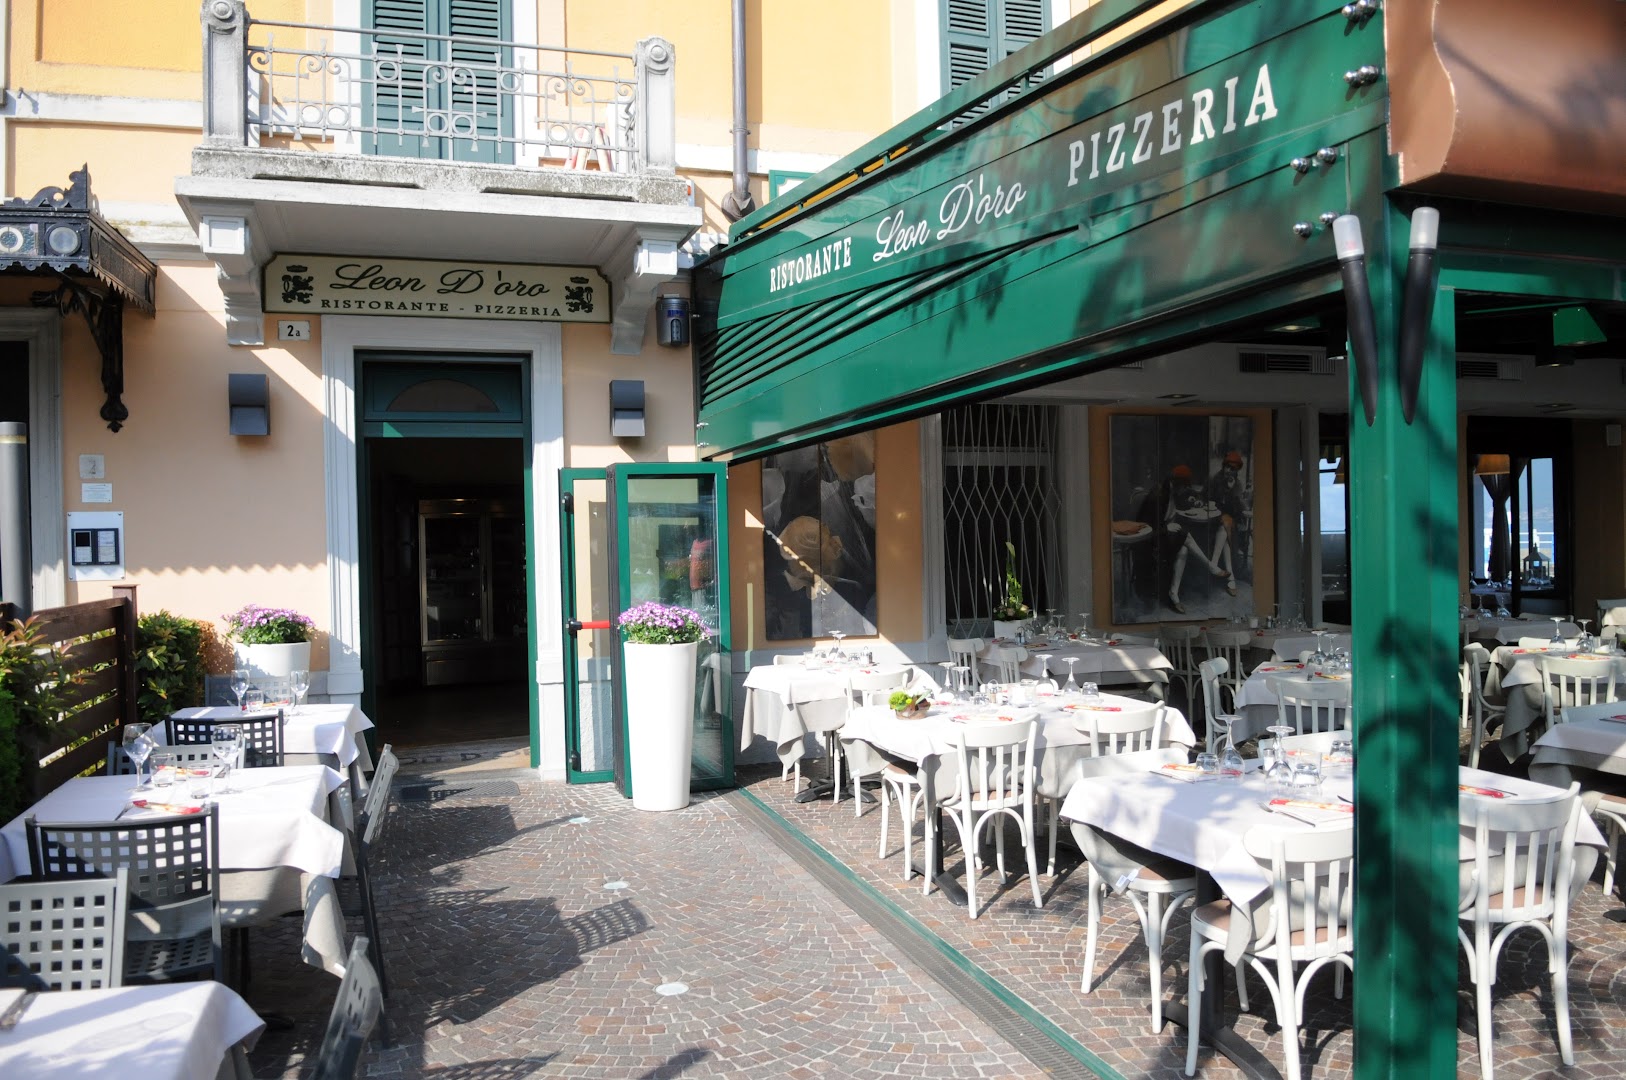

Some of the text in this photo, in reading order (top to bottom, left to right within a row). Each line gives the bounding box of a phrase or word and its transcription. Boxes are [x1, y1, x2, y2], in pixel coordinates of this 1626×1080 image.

[770, 63, 1279, 293] RISTORANTE Leon D'oro PIZZERIA
[329, 263, 551, 298] Leon D'oro
[321, 299, 449, 313] RISTORANTE
[475, 304, 562, 317] PIZZERIA
[286, 324, 301, 337] 2a
